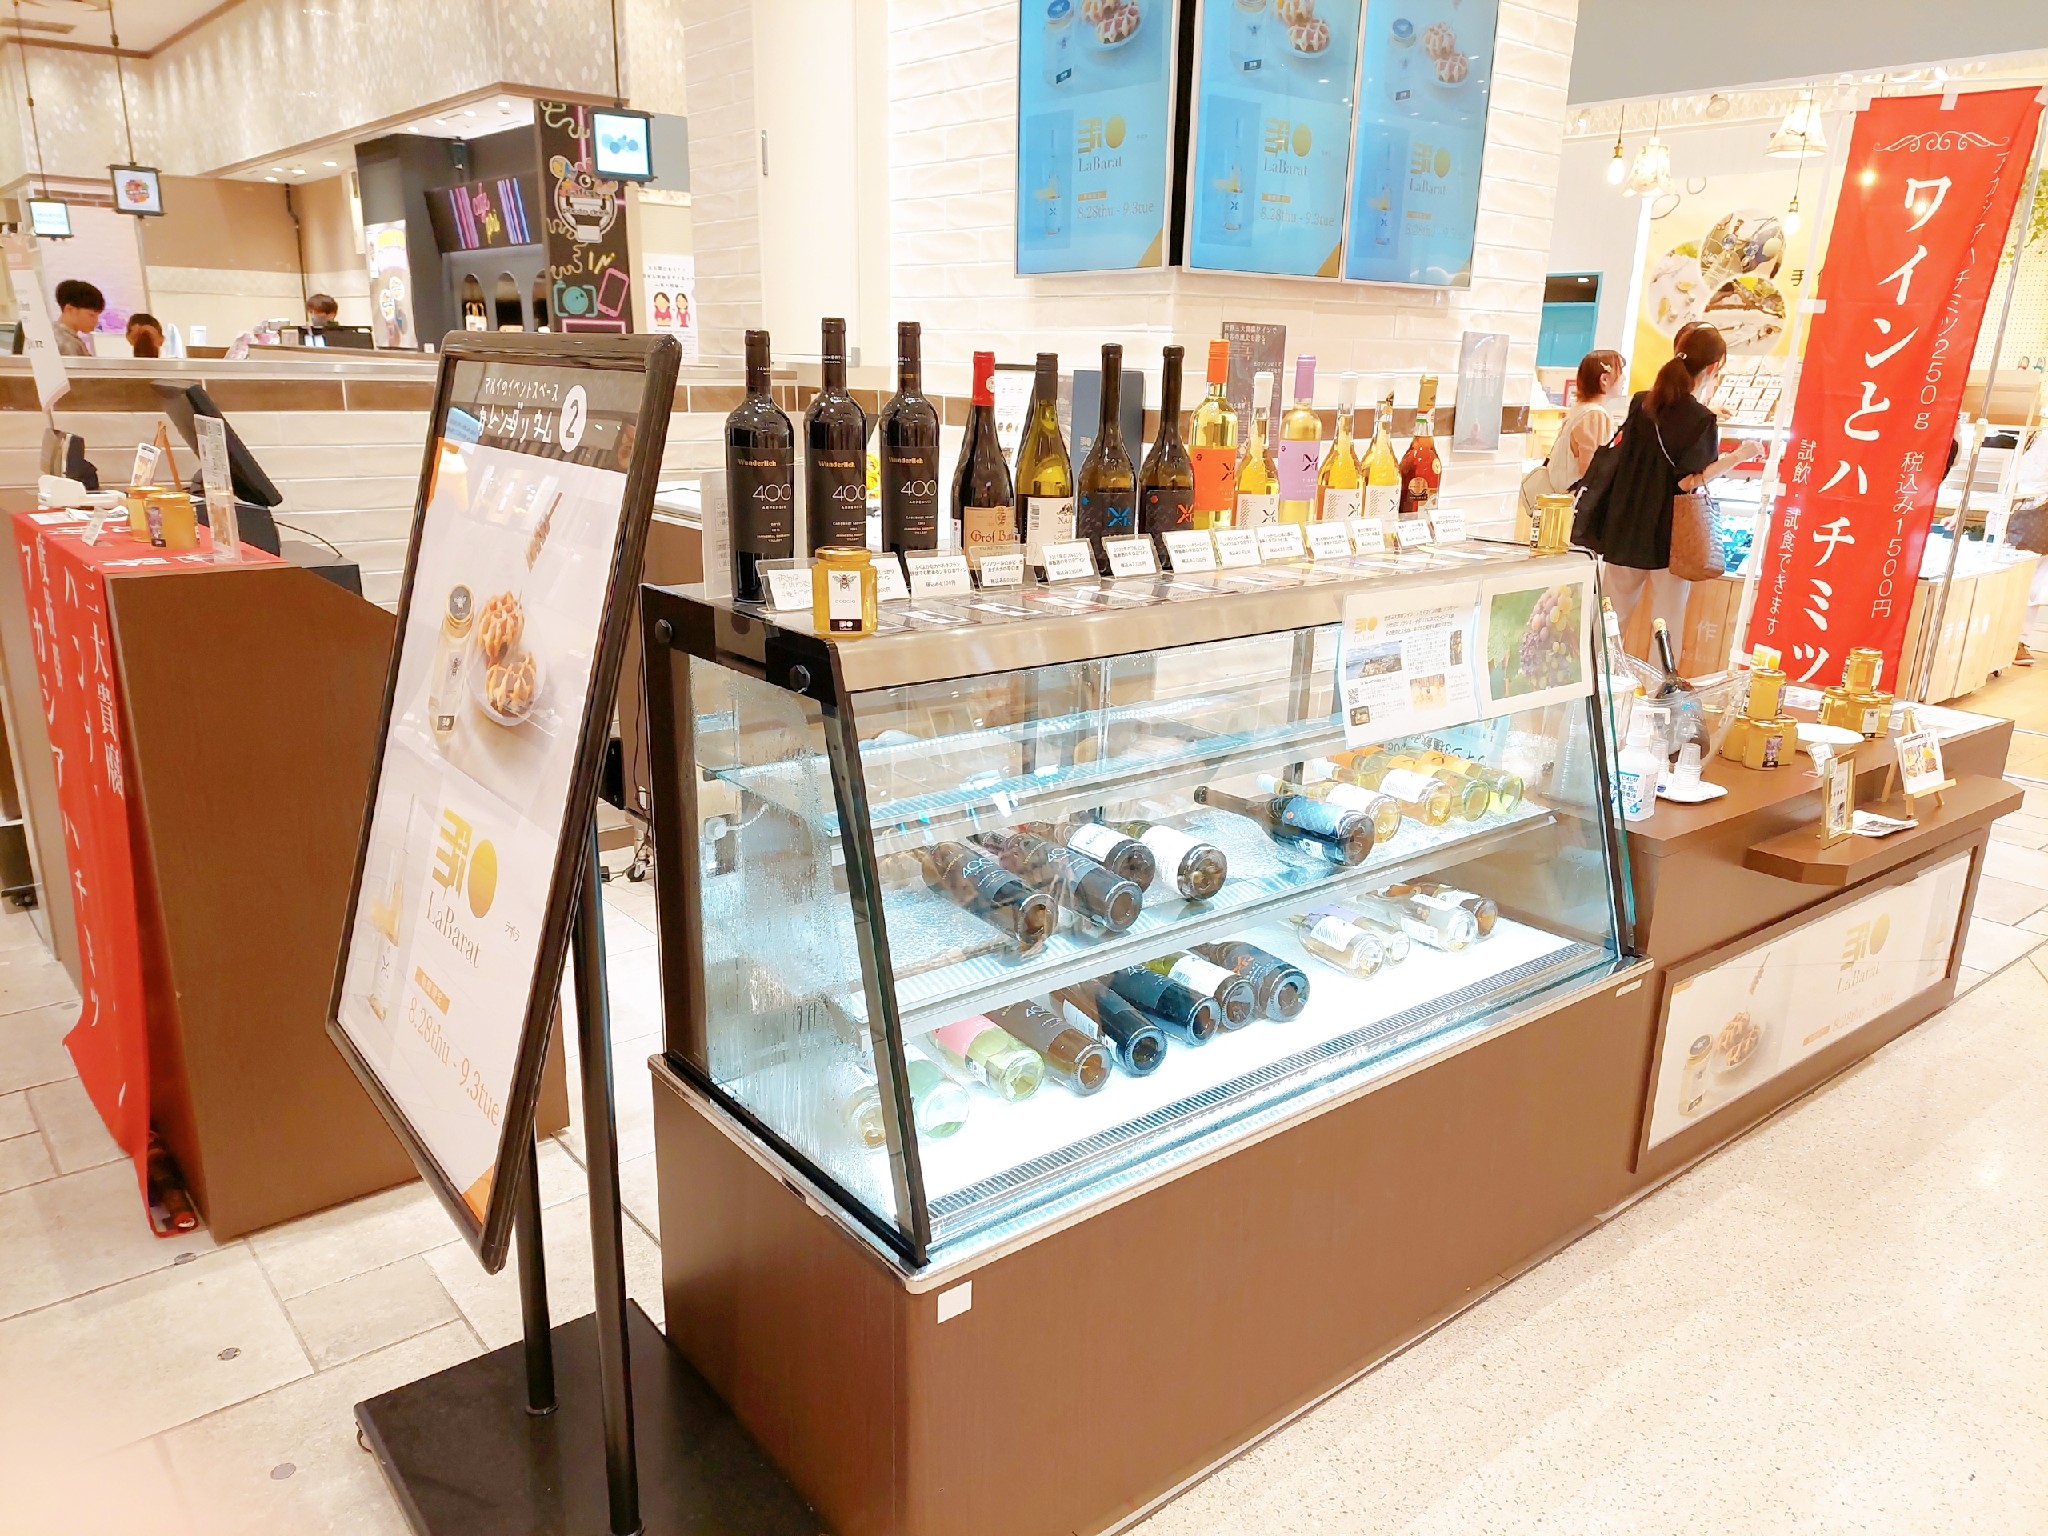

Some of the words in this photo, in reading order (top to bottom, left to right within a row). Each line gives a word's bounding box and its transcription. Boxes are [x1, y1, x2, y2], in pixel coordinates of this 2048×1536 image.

[485, 377, 559, 402] マルイのイベントスペース
[1792, 175, 1953, 683] ワインとハチミツ
[752, 483, 792, 502] 400
[831, 483, 867, 502] 400
[900, 479, 937, 498] 400
[1870, 450, 1925, 619] 税込み1500円
[426, 890, 481, 969] LaBarat
[407, 996, 449, 1067] 8.28thu
[459, 1056, 500, 1127] 9.3tue
